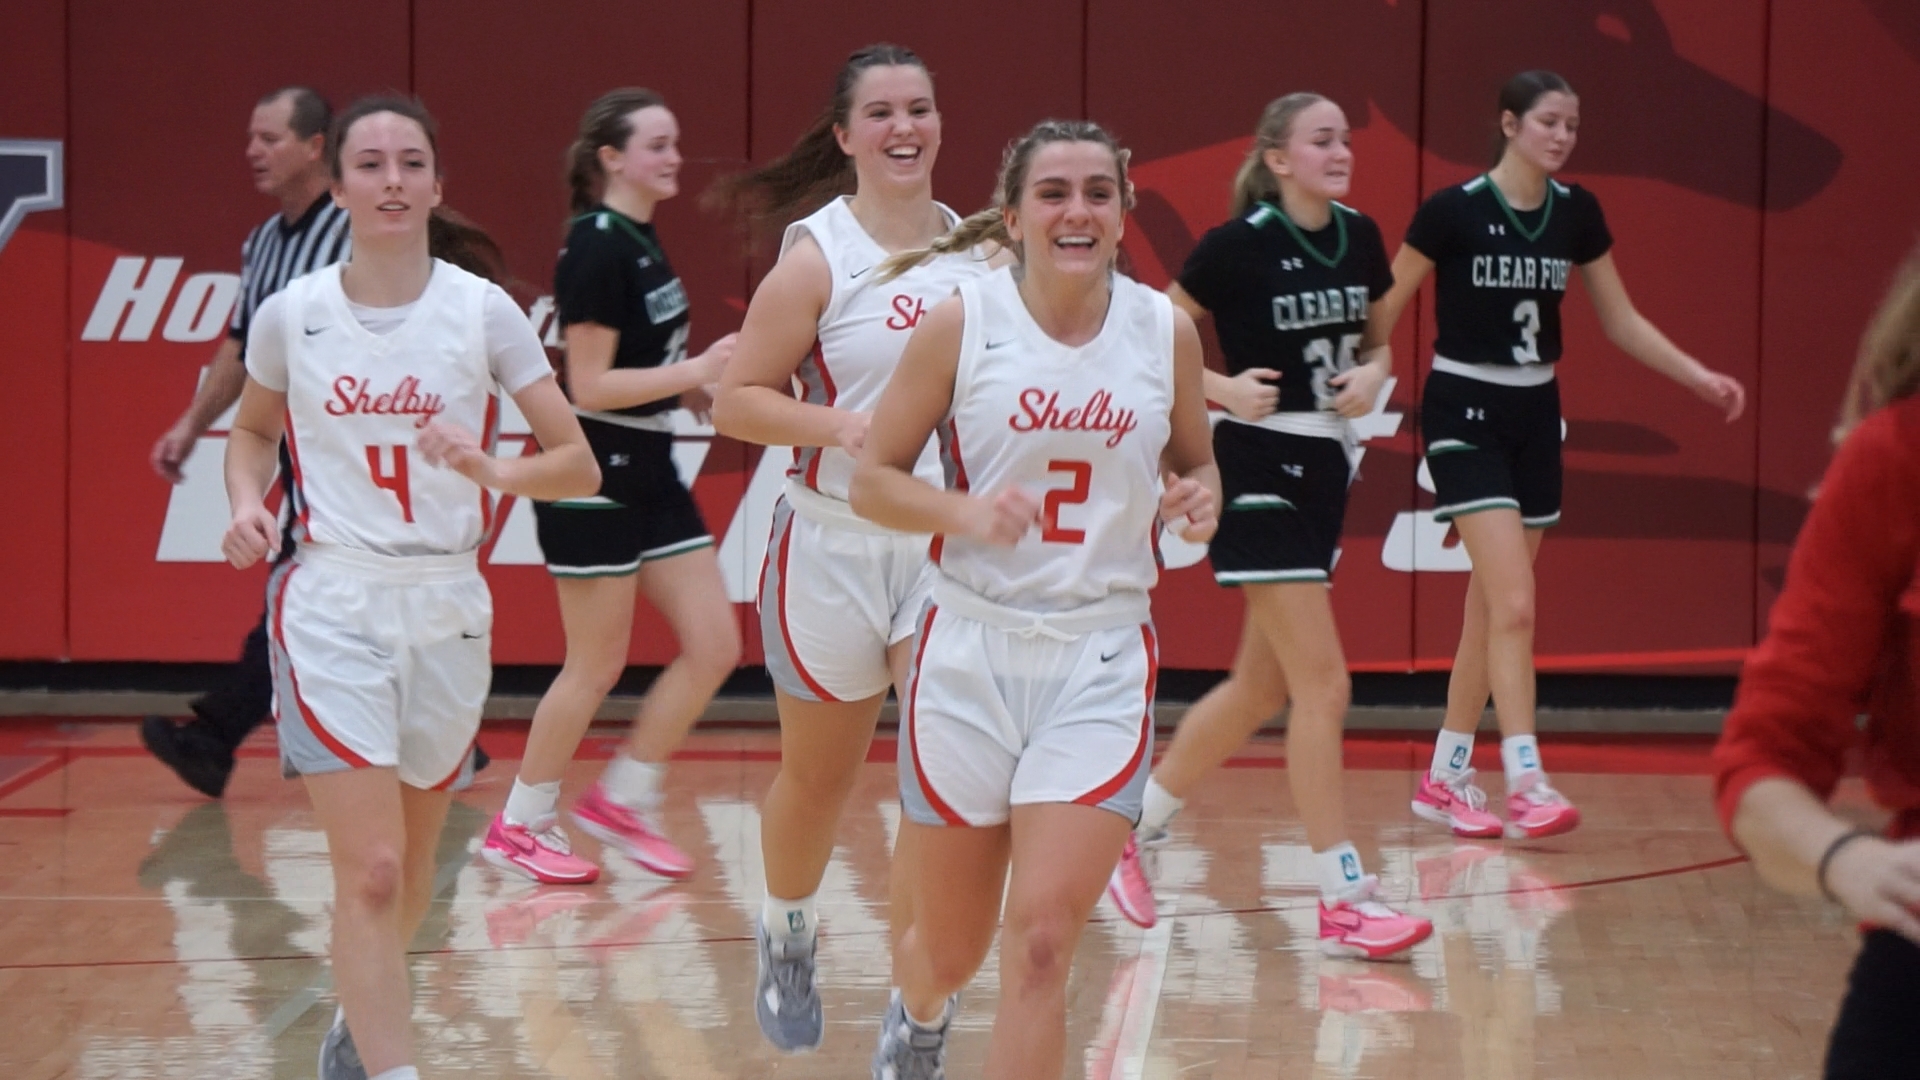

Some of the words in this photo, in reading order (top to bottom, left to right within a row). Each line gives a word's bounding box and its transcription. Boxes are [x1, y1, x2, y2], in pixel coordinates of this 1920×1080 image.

[1471, 254, 1537, 289] CLEAR
[1540, 256, 1573, 291] FOR
[1511, 299, 1541, 364] 3
[324, 374, 446, 429] Shelby
[1008, 387, 1138, 449] Shelby
[365, 444, 416, 524] 4
[1041, 458, 1093, 544] 2
